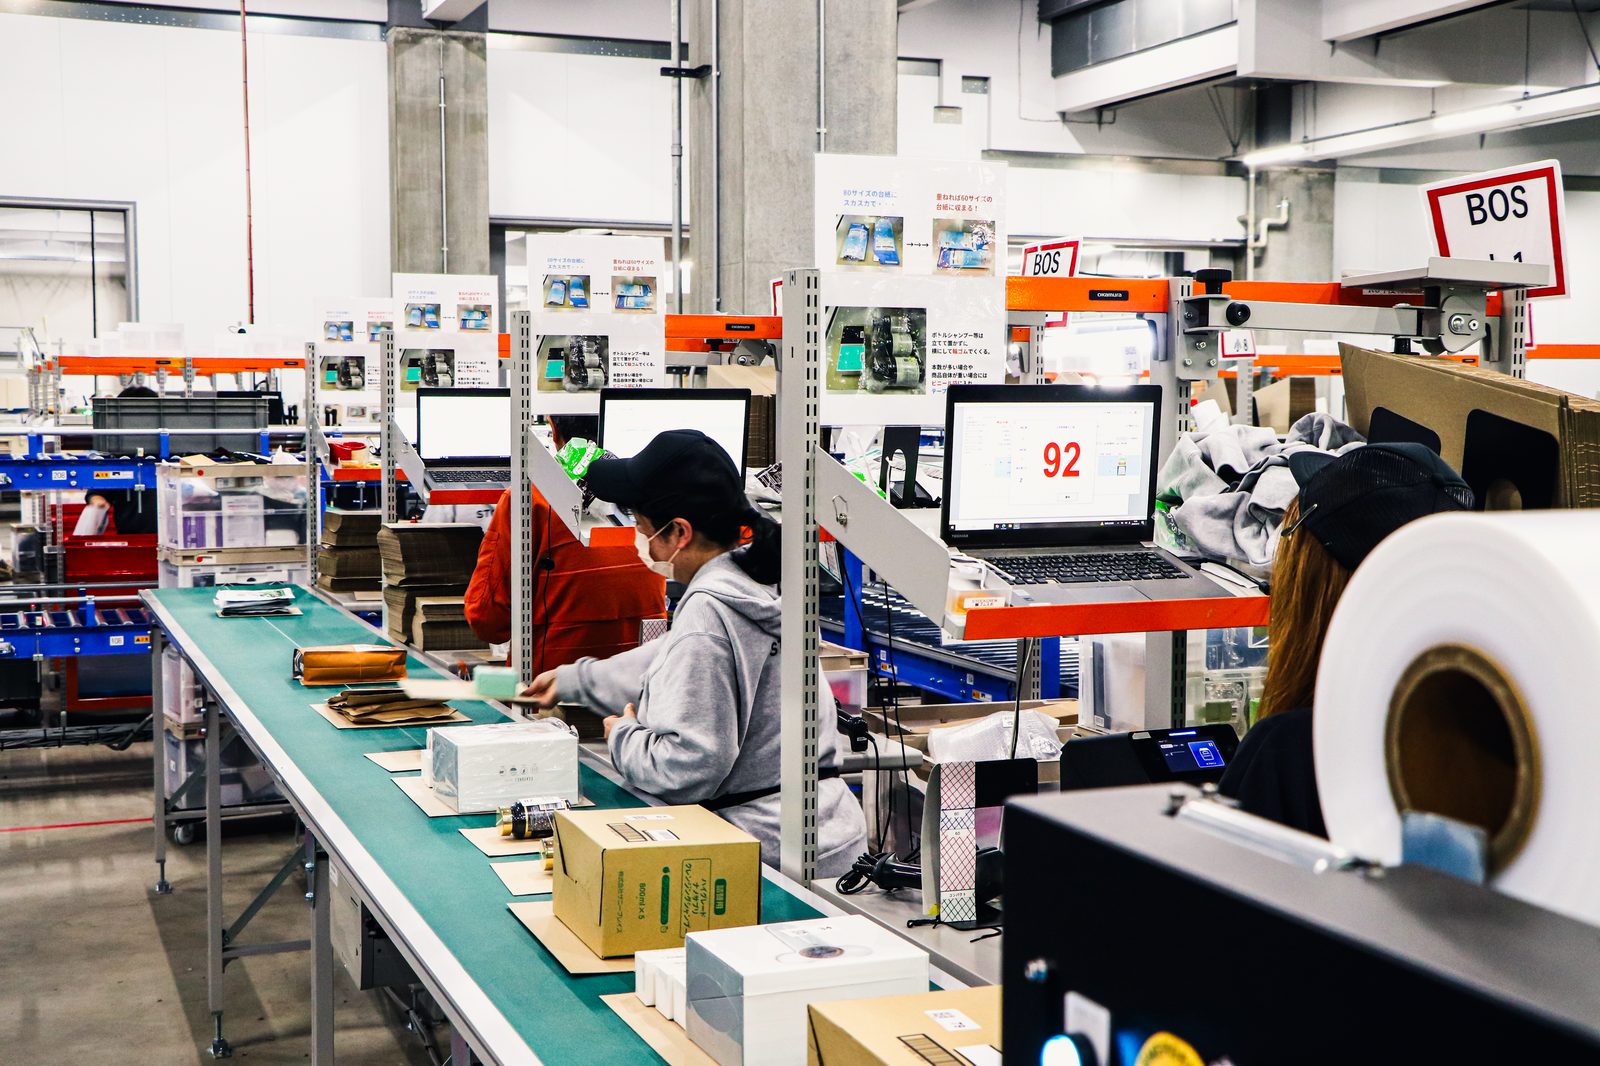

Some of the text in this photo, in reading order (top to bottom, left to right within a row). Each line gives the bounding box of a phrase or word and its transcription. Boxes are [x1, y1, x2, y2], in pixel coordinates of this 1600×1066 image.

[1465, 185, 1529, 226] BOS
[1033, 250, 1061, 276] BOS
[1043, 441, 1081, 478] 92
